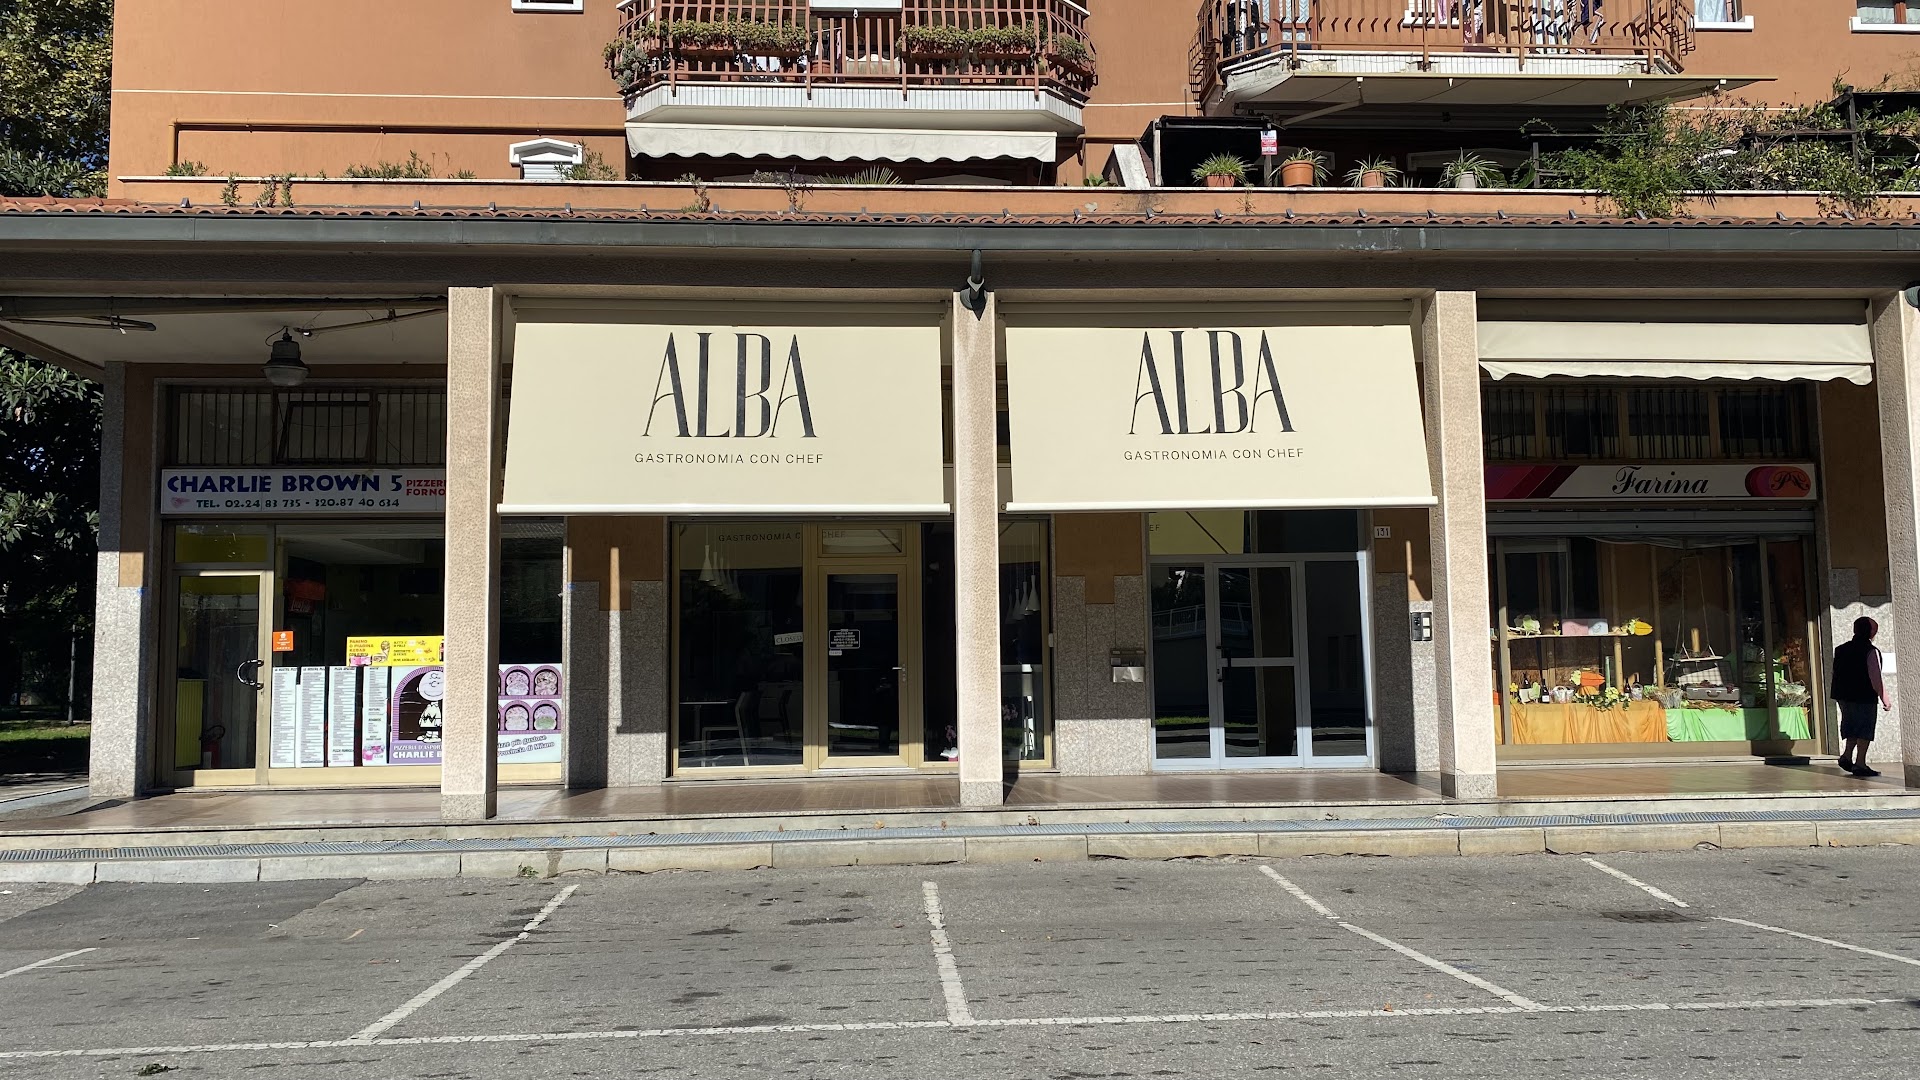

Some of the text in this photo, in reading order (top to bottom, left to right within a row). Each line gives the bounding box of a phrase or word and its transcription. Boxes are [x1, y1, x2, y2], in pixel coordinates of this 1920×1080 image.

[642, 332, 818, 437] ALBA
[1127, 330, 1298, 434] ALBA
[634, 453, 823, 464] GASTRONOMIA CON CHEF
[1124, 448, 1304, 460] GASTRONOMIA CON CHEF
[167, 475, 403, 492] CHARLIE BROWN 5
[1611, 466, 1709, 494] Farina
[406, 488, 446, 496] FORNO
[196, 499, 220, 508] TEL.
[225, 499, 260, 508] 02.24
[265, 499, 278, 508] 83
[282, 499, 301, 508] 735
[315, 498, 353, 507] 320.87
[358, 498, 374, 507] 40
[378, 498, 400, 507] 634
[718, 532, 792, 542] GASTRONOMIA
[1376, 527, 1389, 537] 131
[392, 750, 434, 759] CHARLIE
